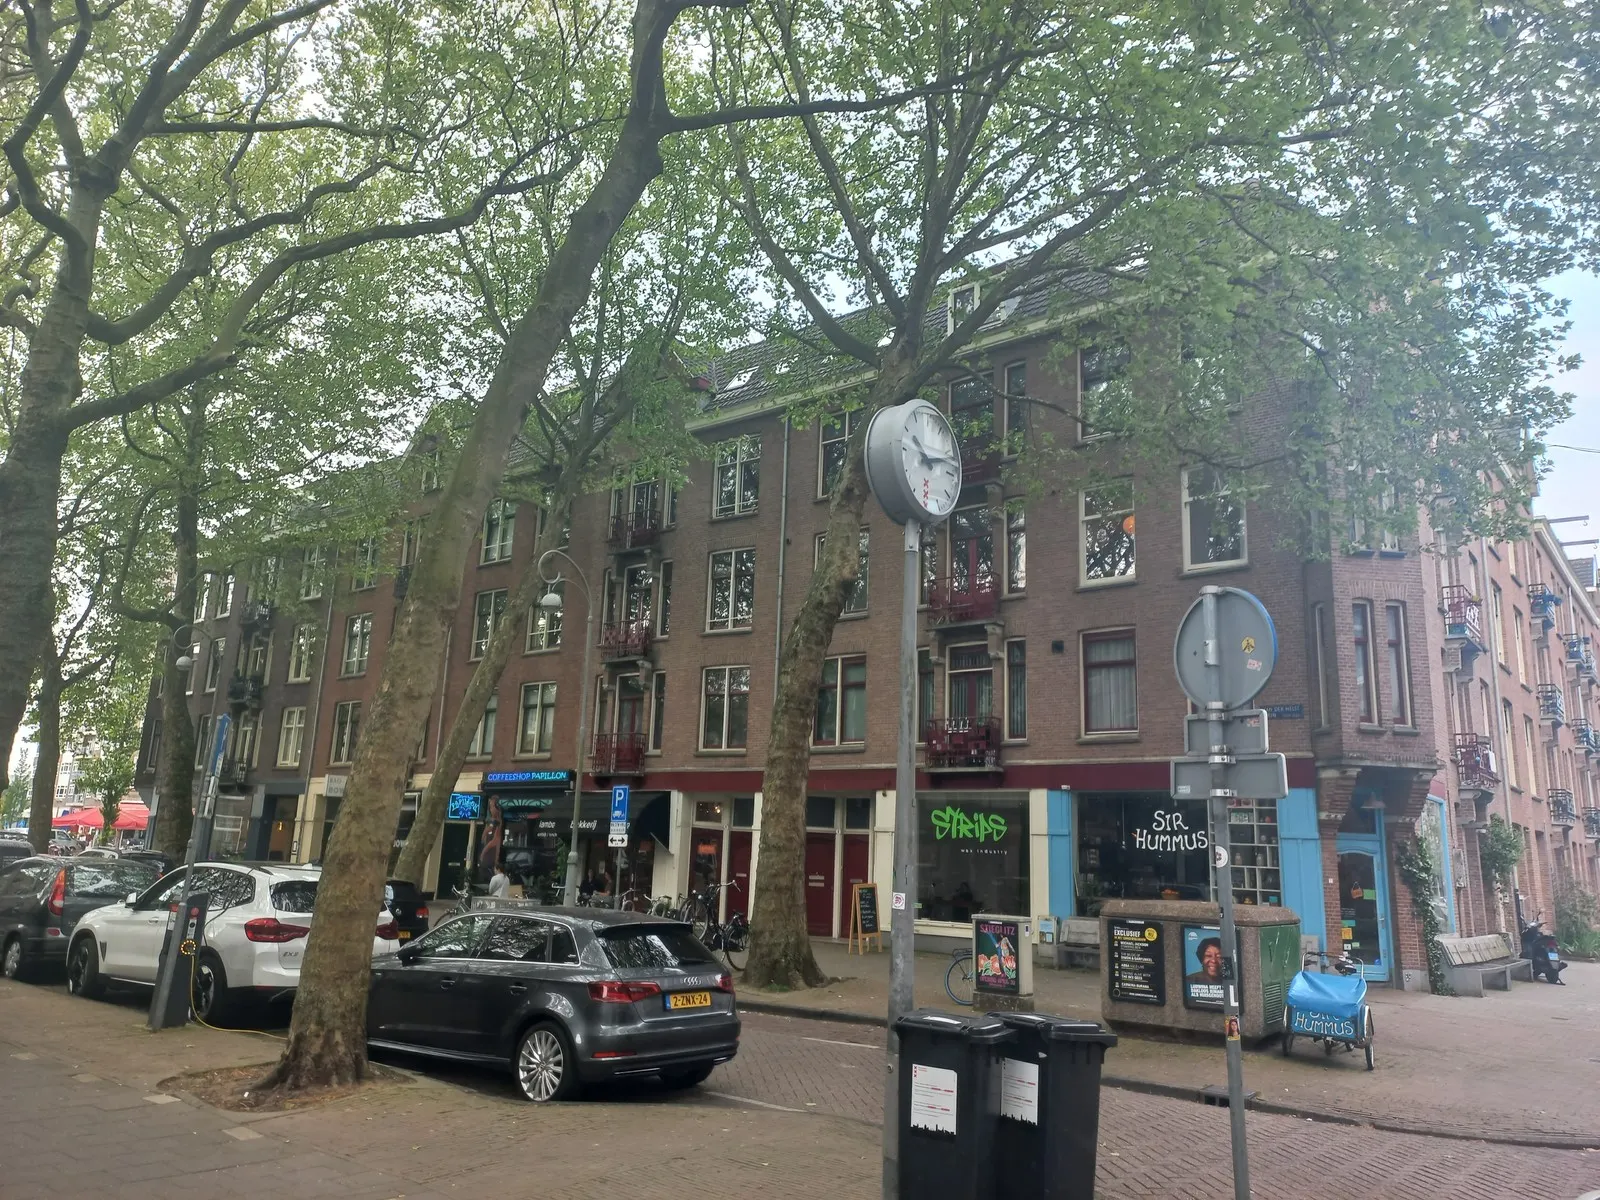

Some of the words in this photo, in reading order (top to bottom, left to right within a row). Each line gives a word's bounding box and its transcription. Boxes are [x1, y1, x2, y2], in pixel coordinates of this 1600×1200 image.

[488, 773, 531, 781] COFFEESHOP
[531, 772, 567, 780] PAPILLON
[615, 789, 624, 807] P
[1152, 810, 1189, 831] SIR
[1136, 828, 1208, 851] HUMMUS
[980, 924, 1015, 935] STIEGLITZ
[1114, 930, 1141, 938] EXCLUSIEF
[673, 993, 708, 1006] 2-ZNX-24
[1294, 1011, 1354, 1035] HUMMUS
